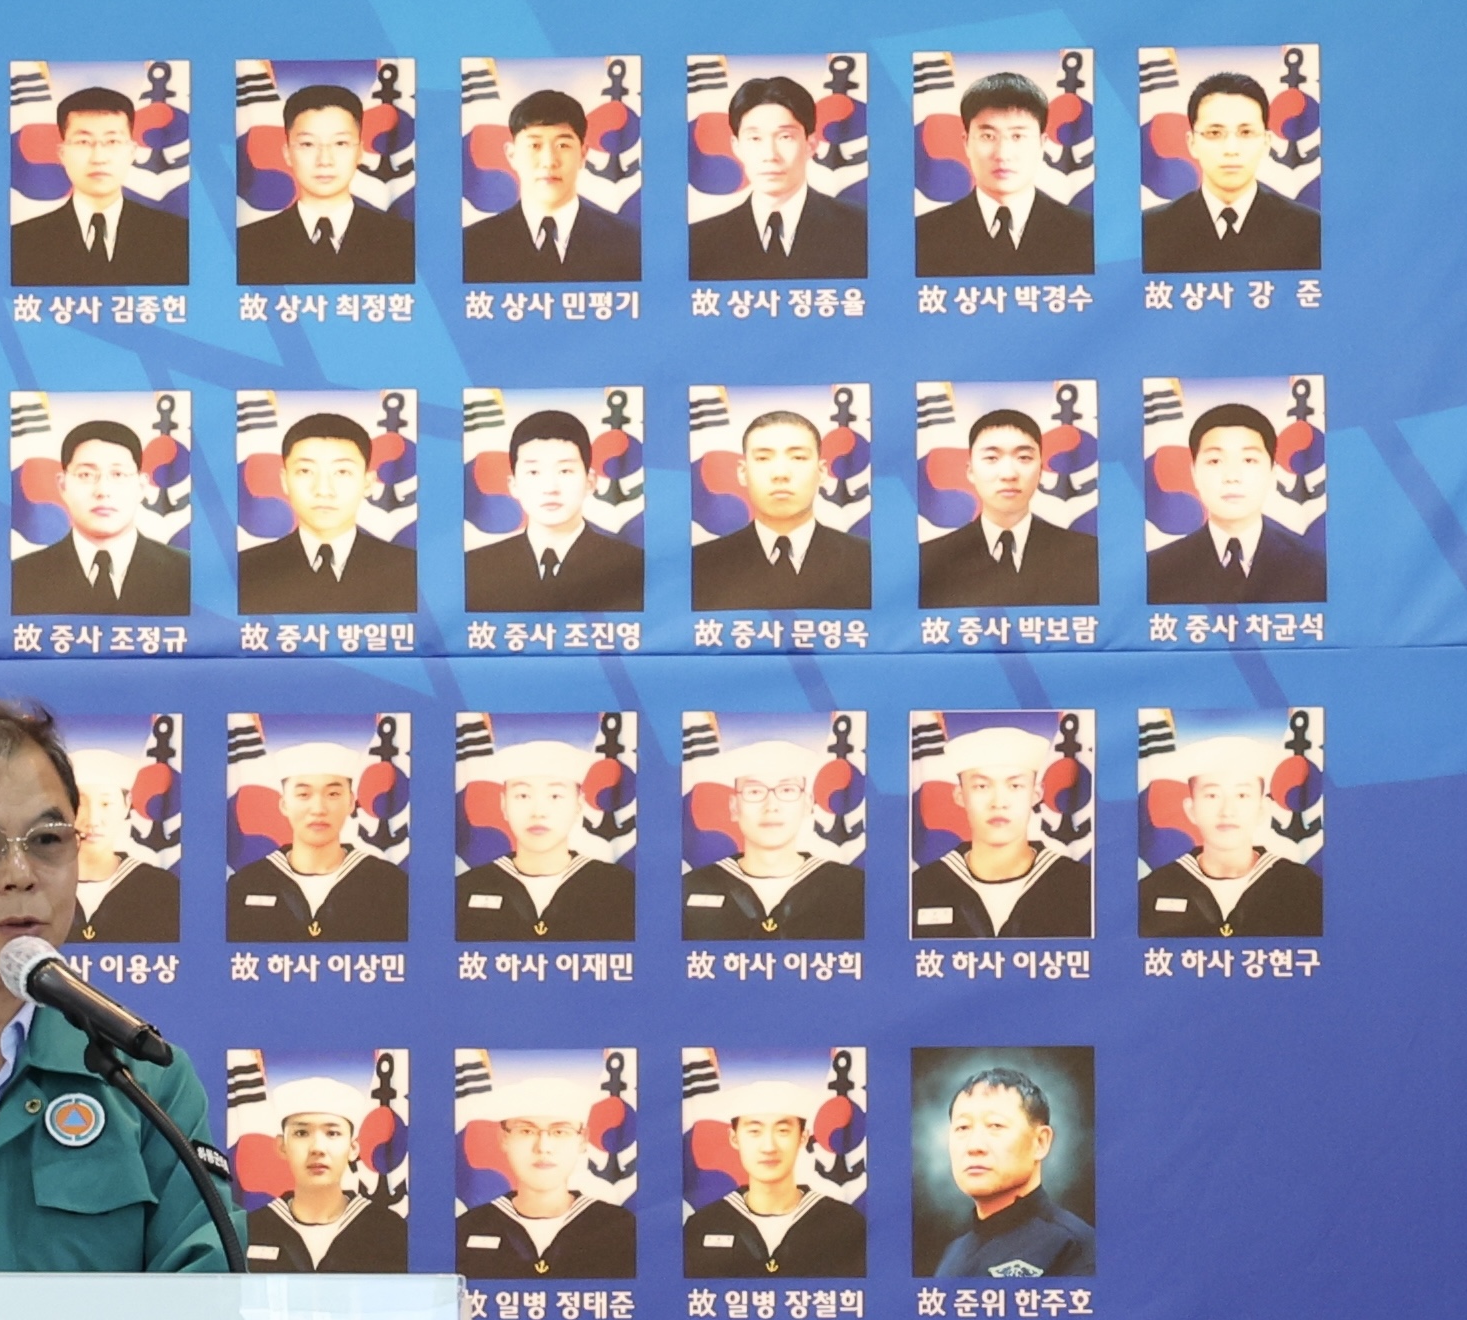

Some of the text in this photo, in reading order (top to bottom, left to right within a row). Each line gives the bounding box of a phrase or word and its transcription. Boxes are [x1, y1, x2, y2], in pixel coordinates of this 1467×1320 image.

[13, 293, 187, 325] 故 상사 김종헌
[691, 288, 866, 319] 故 상사 정종율
[917, 284, 1094, 316] 故 상사 박경수
[13, 622, 188, 654] 故 중사 조정규
[239, 622, 414, 653] 故 중사 방일민
[693, 618, 869, 649] 故 중사 문영욱
[920, 615, 1099, 646] 故 중사 박보람
[230, 951, 405, 983] 故 하사 이상민
[458, 951, 633, 982] 故 하사 이재민
[915, 949, 1090, 980] 故 하사 이상민
[687, 1288, 864, 1320] 故 일병 장철희
[917, 1287, 1094, 1318] 故 준위 한주호
